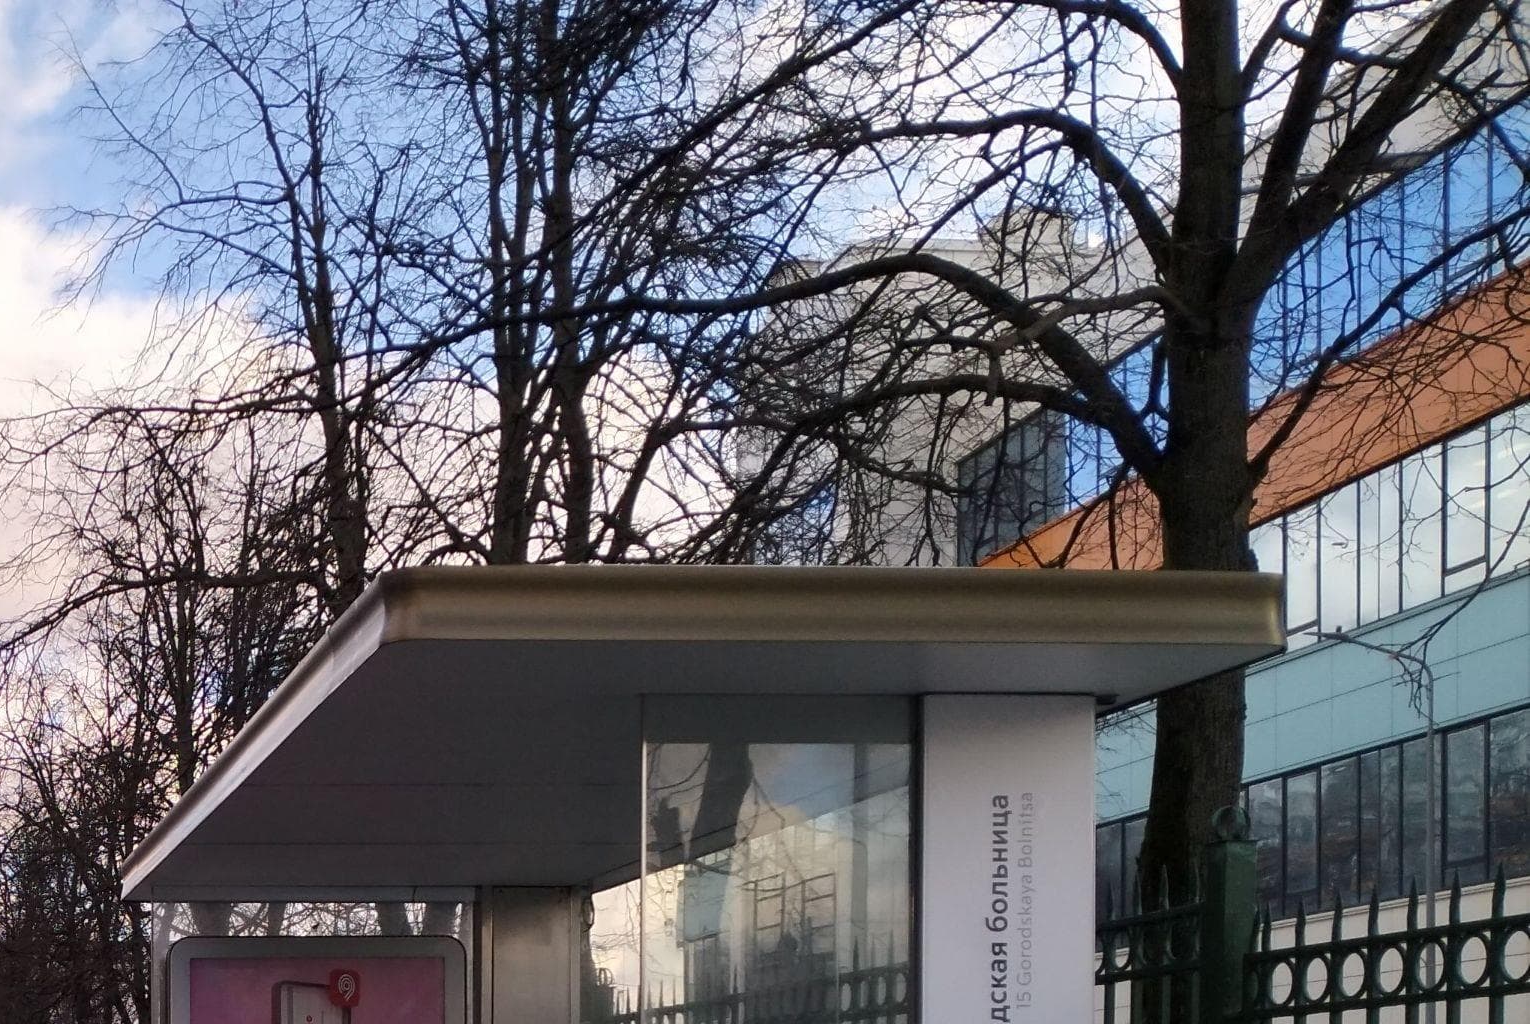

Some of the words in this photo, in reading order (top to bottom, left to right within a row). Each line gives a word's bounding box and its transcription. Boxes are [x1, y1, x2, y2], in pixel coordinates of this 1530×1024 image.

[985, 794, 1013, 932] больница
[1018, 792, 1033, 868] Bolnitsa
[1017, 874, 1036, 986] Gorodskaya
[1017, 991, 1032, 1010] 15
